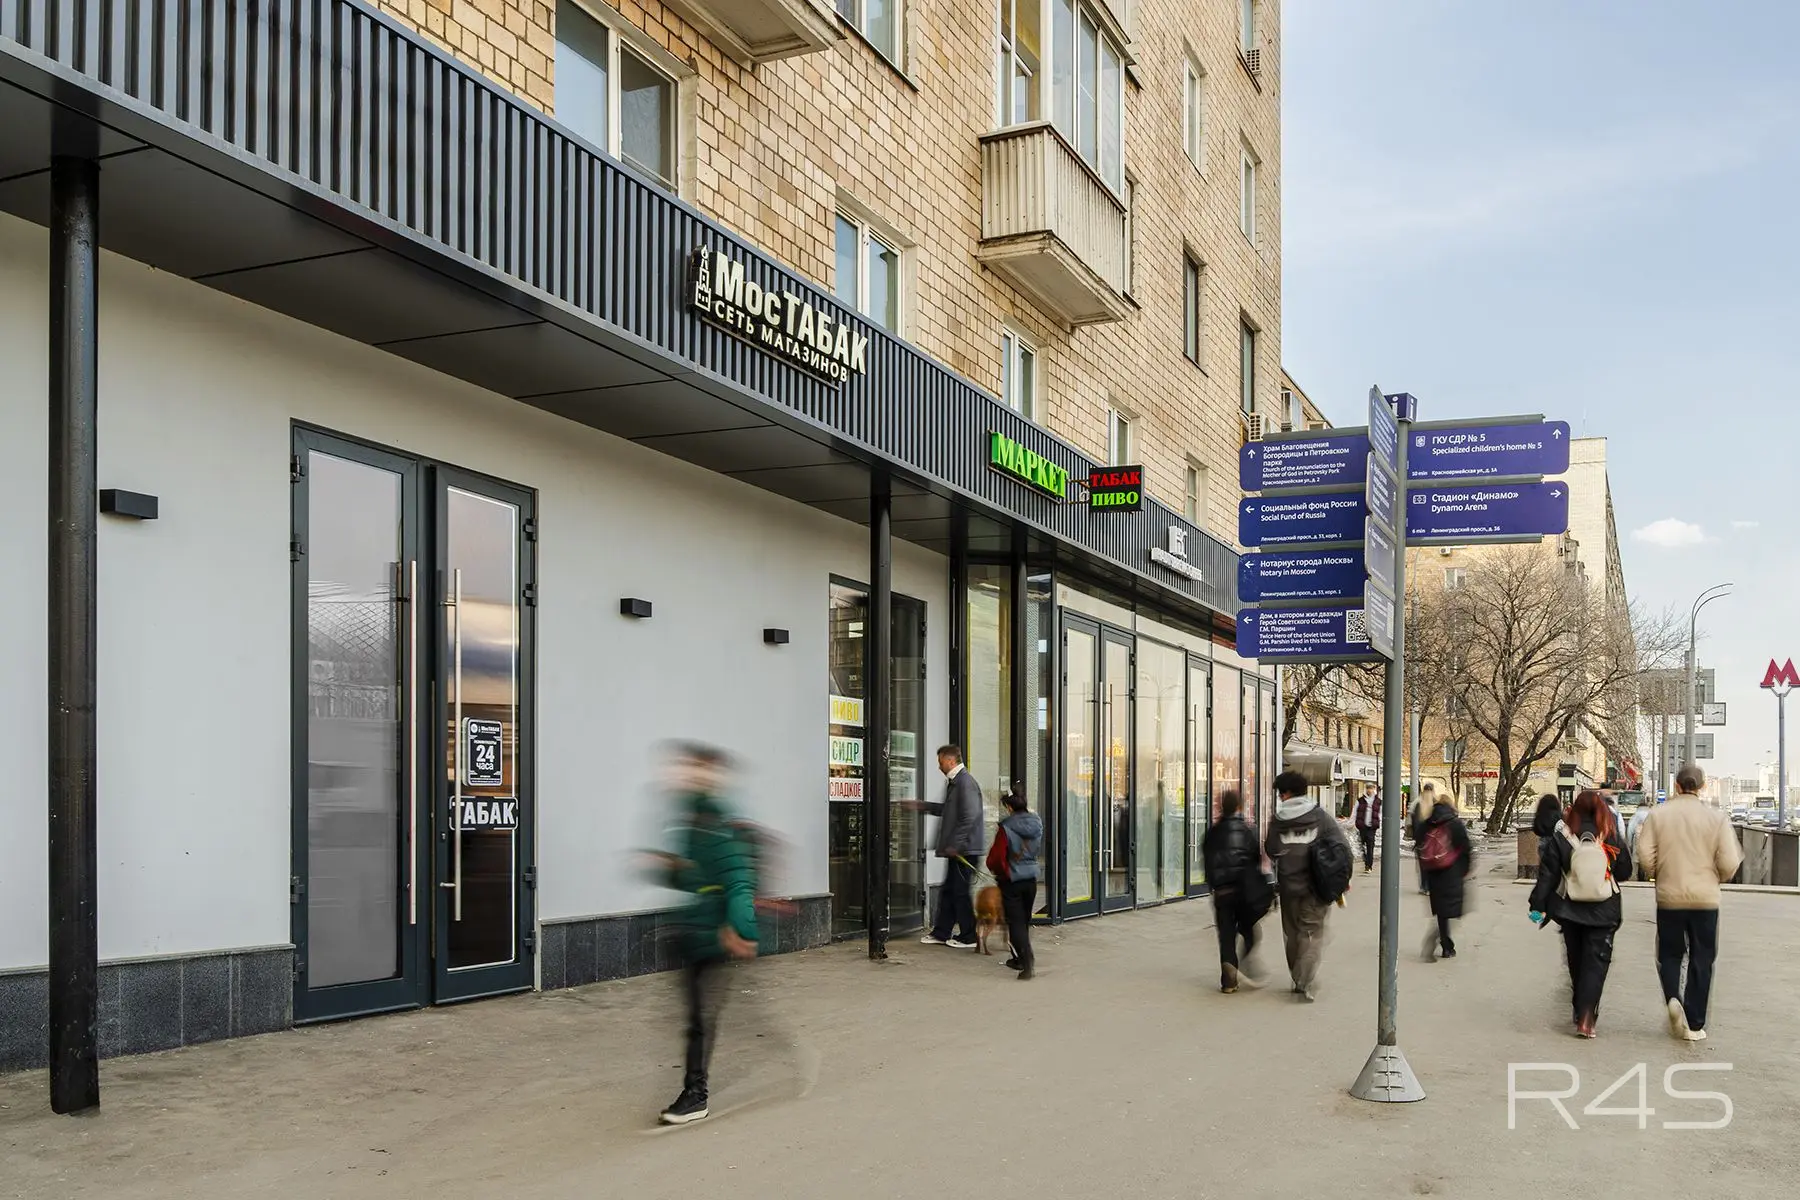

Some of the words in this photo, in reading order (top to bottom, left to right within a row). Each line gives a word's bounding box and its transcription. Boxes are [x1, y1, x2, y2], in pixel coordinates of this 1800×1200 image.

[715, 251, 868, 376] МосТАБАК
[714, 300, 755, 335] СЕТЬ
[761, 323, 848, 383] МАГАЗИНОВ
[1432, 436, 1448, 444] ГКУ
[1448, 435, 1466, 445] СДР
[1467, 434, 1478, 442] №
[1480, 433, 1486, 441] 5
[1263, 451, 1303, 460] Богородицы
[1309, 447, 1349, 456] Петровском
[1281, 442, 1329, 451] Благовещения
[1432, 445, 1470, 456] Specialized
[1537, 441, 1543, 449] 5
[991, 431, 1068, 499] МАРКЕТ
[1090, 471, 1141, 487] ТАБАК
[1091, 491, 1139, 506] ПИВО
[1431, 493, 1469, 503] Стадион
[1470, 491, 1519, 502] «Динамо»
[1260, 502, 1307, 513] Социальный
[1308, 501, 1329, 511] фонд
[1330, 500, 1358, 508] России
[1431, 504, 1463, 514] Dynamo
[1464, 503, 1487, 511] Arena
[1260, 513, 1280, 522] Social
[1280, 512, 1296, 521] Fund
[1305, 511, 1326, 519] Russia
[1260, 560, 1295, 568] Нотариус
[1296, 559, 1322, 567] города
[1323, 557, 1353, 565] Москвы
[1260, 569, 1282, 577] Notary
[832, 700, 860, 722] ПИВО
[476, 744, 495, 763] 24
[832, 740, 860, 764] СИДР
[476, 762, 495, 771] часа
[830, 781, 862, 799] СЛАДКОЕ
